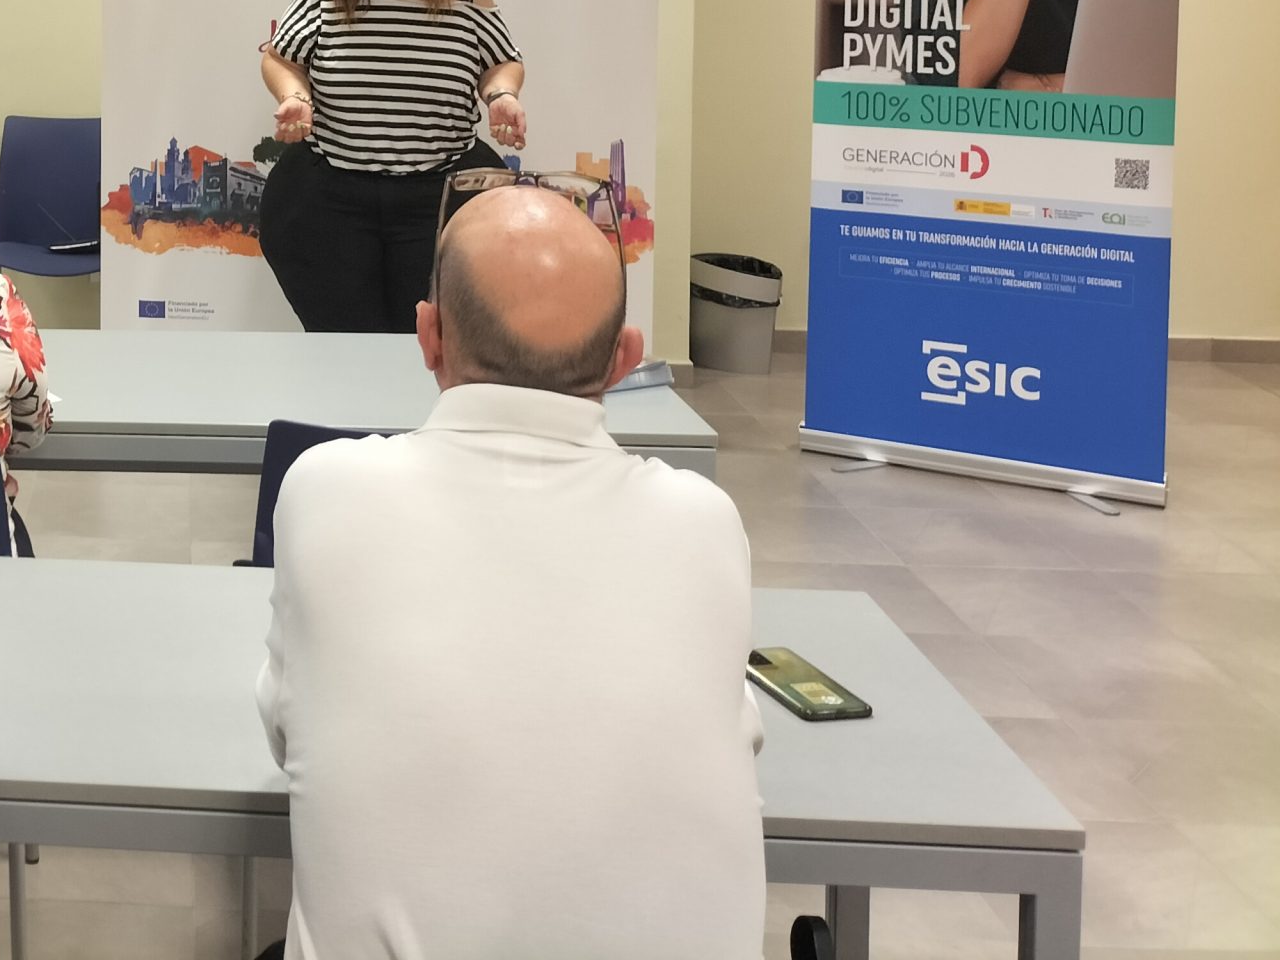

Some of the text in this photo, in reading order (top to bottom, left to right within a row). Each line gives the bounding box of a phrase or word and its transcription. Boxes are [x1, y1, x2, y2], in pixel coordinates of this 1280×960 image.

[842, 32, 957, 76] PYMES
[841, 90, 1144, 138] 100% SUBVENCIONADO
[842, 146, 956, 169] GENERACIÓN
[840, 224, 1135, 263] TE GUIAMOS EN TU TRANSFORMACIÓN HACIA LA GENERACIÓN DIGITAL
[879, 256, 909, 266] EFICIENCIA
[970, 265, 1016, 277] INTERNACIONAL
[1086, 276, 1122, 288] DECISIONES
[931, 271, 961, 281] PROCESOS
[1002, 278, 1042, 290] CRECIMIENTO
